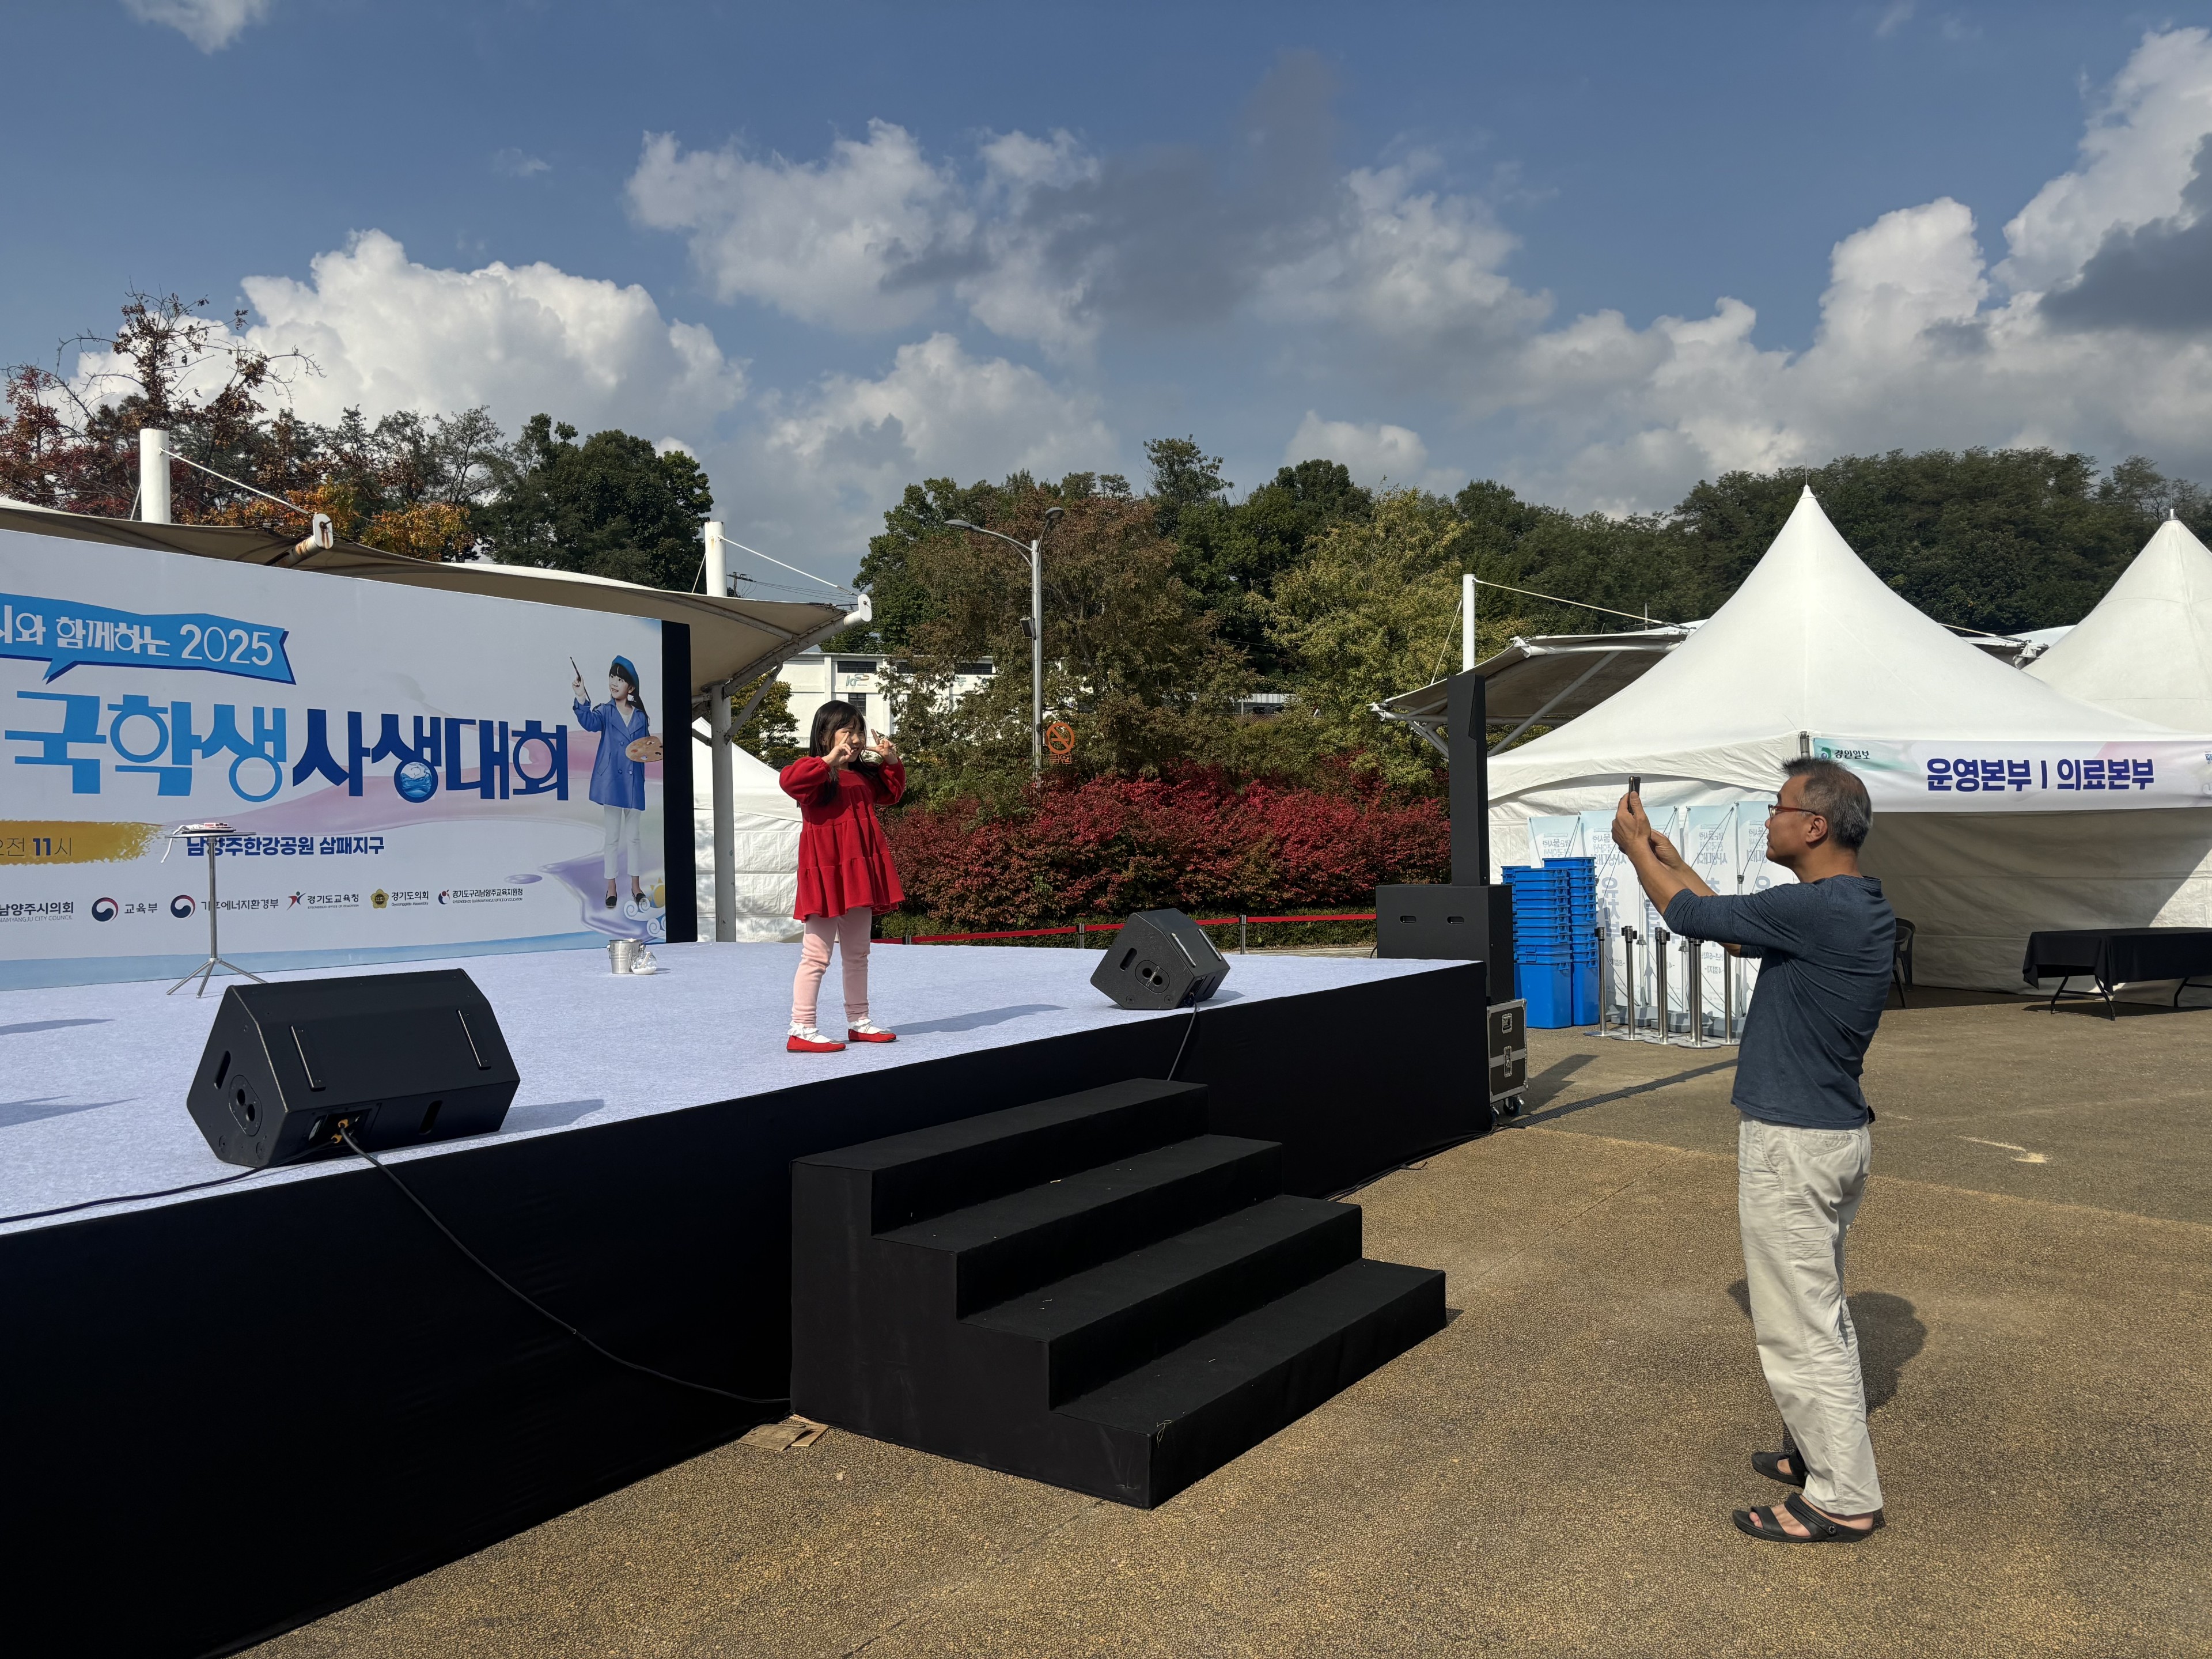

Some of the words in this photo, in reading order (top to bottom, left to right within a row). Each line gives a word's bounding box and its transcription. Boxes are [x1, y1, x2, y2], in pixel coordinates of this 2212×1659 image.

[56, 616, 171, 657] 함께하는
[180, 624, 273, 666] 2025
[1834, 749, 1870, 760] 경인일보
[1927, 757, 2032, 792] 운영본부
[2056, 759, 2154, 791] 의료본부
[320, 836, 384, 855] 삼패지구
[307, 893, 359, 904] 경기도교육청
[392, 891, 429, 901] 경기도의회
[0, 902, 74, 916] 남양주시의회
[124, 903, 158, 915] 교육부
